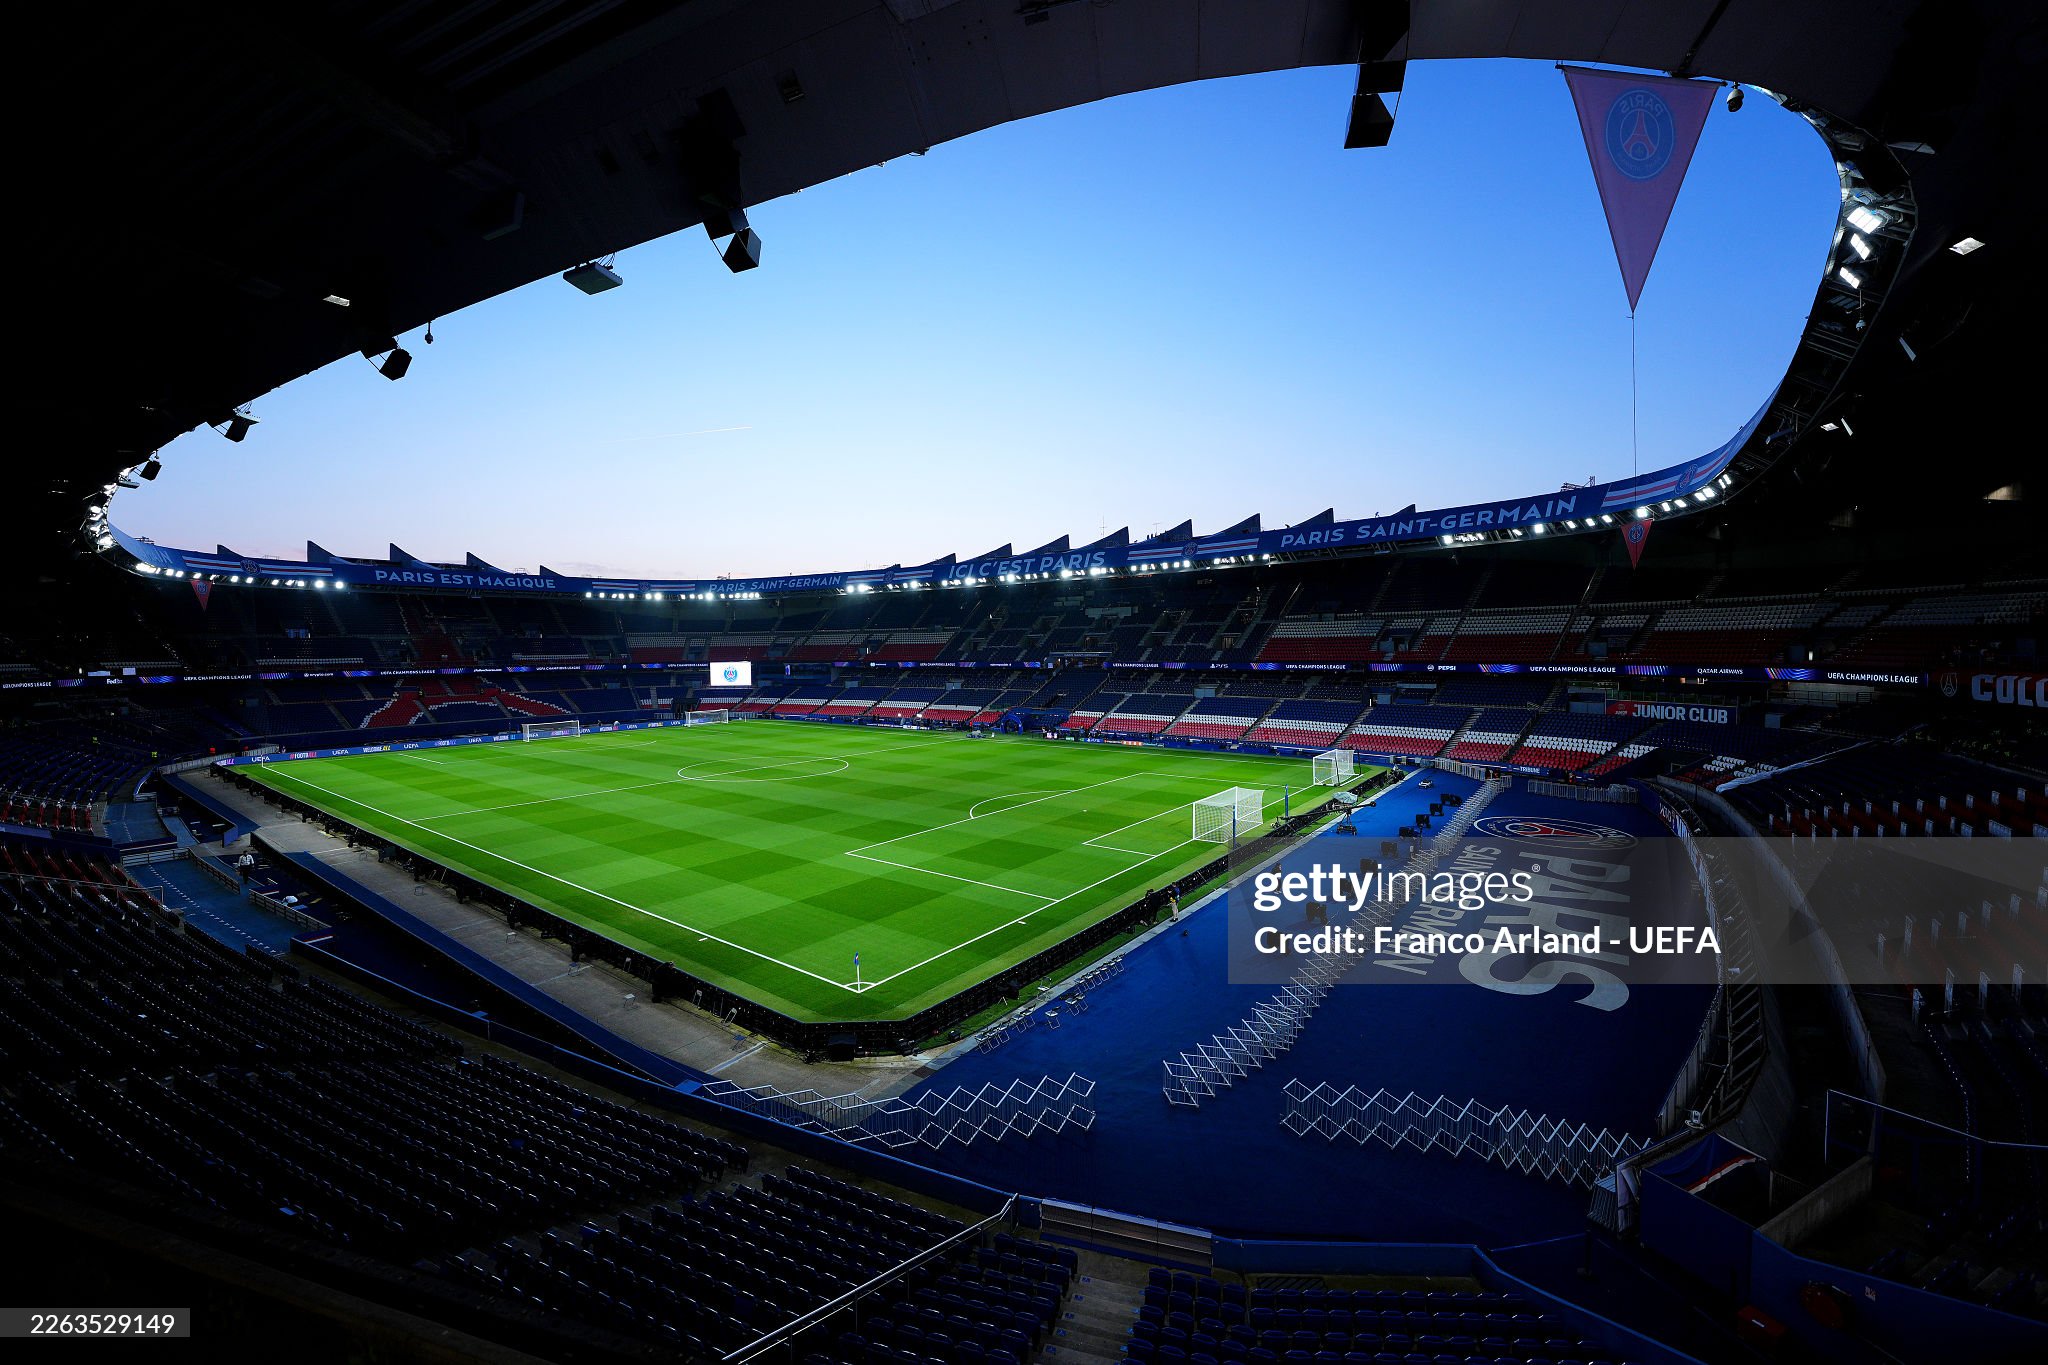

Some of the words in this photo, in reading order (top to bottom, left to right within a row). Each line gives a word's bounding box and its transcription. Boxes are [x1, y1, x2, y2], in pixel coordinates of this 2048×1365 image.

[1281, 528, 1345, 548] PARIS
[1356, 495, 1577, 540] SAINT-GERMAIN
[949, 563, 974, 579] ICI
[979, 558, 1036, 577] C'EST
[1040, 551, 1106, 572] PARIS
[375, 570, 435, 583] PARIS
[441, 573, 474, 585] EST
[478, 576, 556, 589] MAGIQUE
[709, 582, 746, 593] PARIS
[750, 575, 842, 591] SAINT-GERMAIN
[1827, 672, 1845, 680] UEFA
[1845, 673, 1889, 682] CHAMPIONS
[1890, 675, 1919, 684] LEAGUE
[1632, 703, 1686, 721] JUNIOR
[1688, 707, 1728, 724] CLUB
